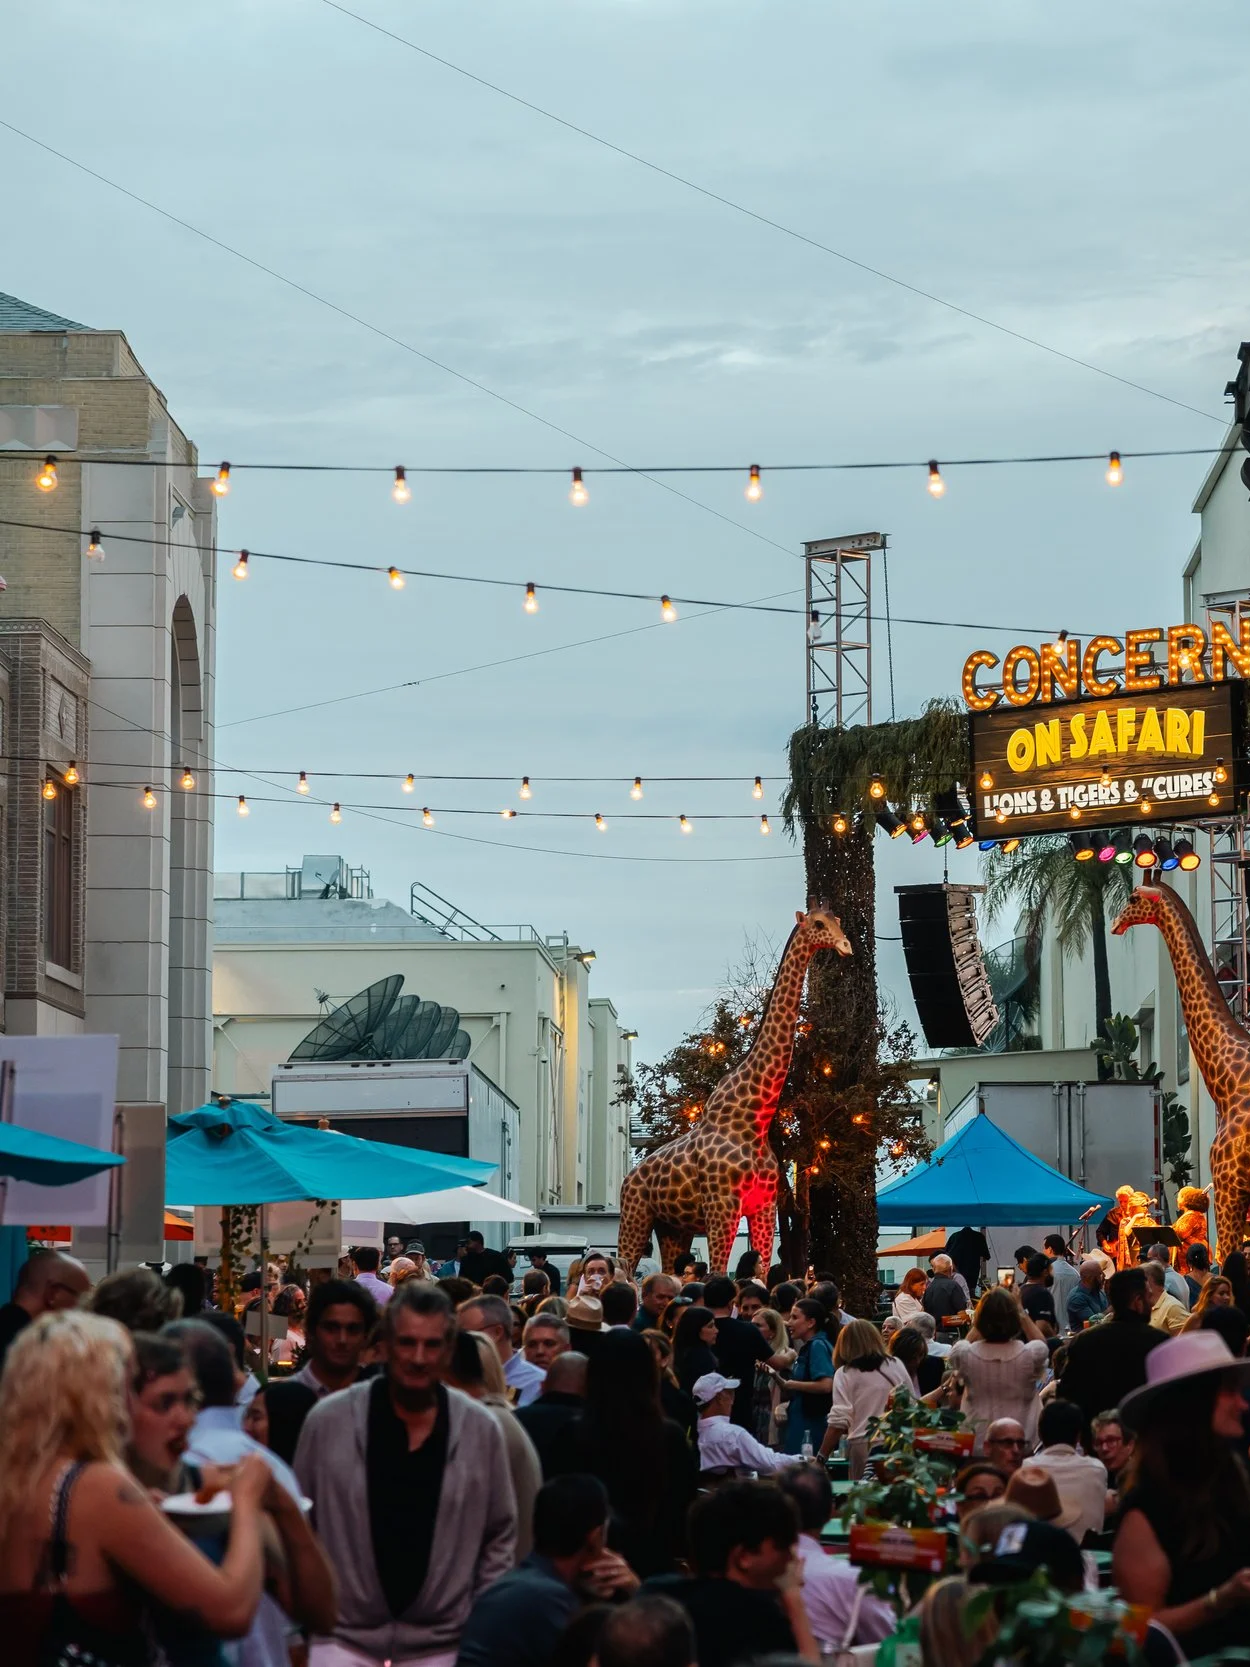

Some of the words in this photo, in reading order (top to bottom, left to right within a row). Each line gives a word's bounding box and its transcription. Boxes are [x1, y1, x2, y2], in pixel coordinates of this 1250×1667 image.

[1006, 718, 1063, 773] ON
[1069, 707, 1206, 760] SAFARI
[983, 790, 1038, 818] LIONS
[1040, 788, 1055, 812] &
[1057, 781, 1121, 810] TIGERS
[1123, 779, 1140, 803] &
